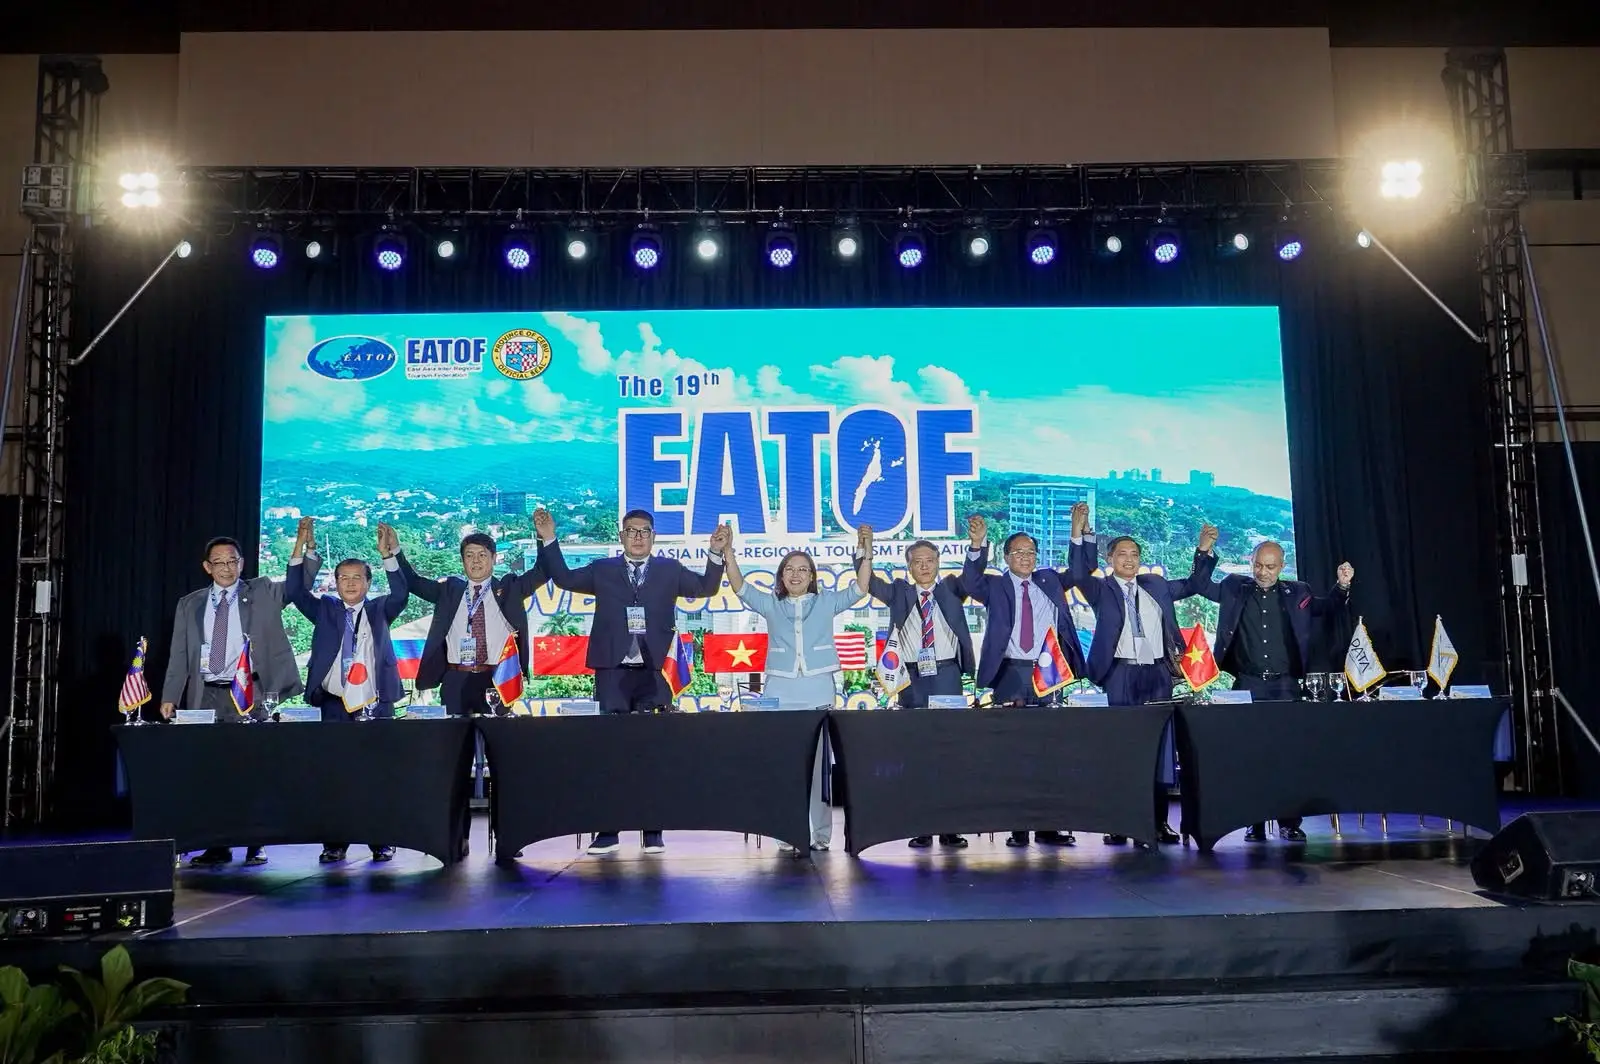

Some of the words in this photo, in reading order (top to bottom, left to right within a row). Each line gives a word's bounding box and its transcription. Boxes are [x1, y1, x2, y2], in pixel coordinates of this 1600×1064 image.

[407, 338, 486, 363] EATOF
[495, 331, 524, 352] PROVINCE
[536, 336, 550, 352] CEBU
[344, 353, 395, 361] EATOF
[498, 364, 528, 378] OFFICIAL
[530, 362, 547, 376] SEAL
[618, 375, 662, 396] The
[674, 372, 720, 396] 19th
[623, 407, 974, 535] EATOF
[656, 547, 692, 559] ASIA
[824, 544, 892, 558] TOUSM
